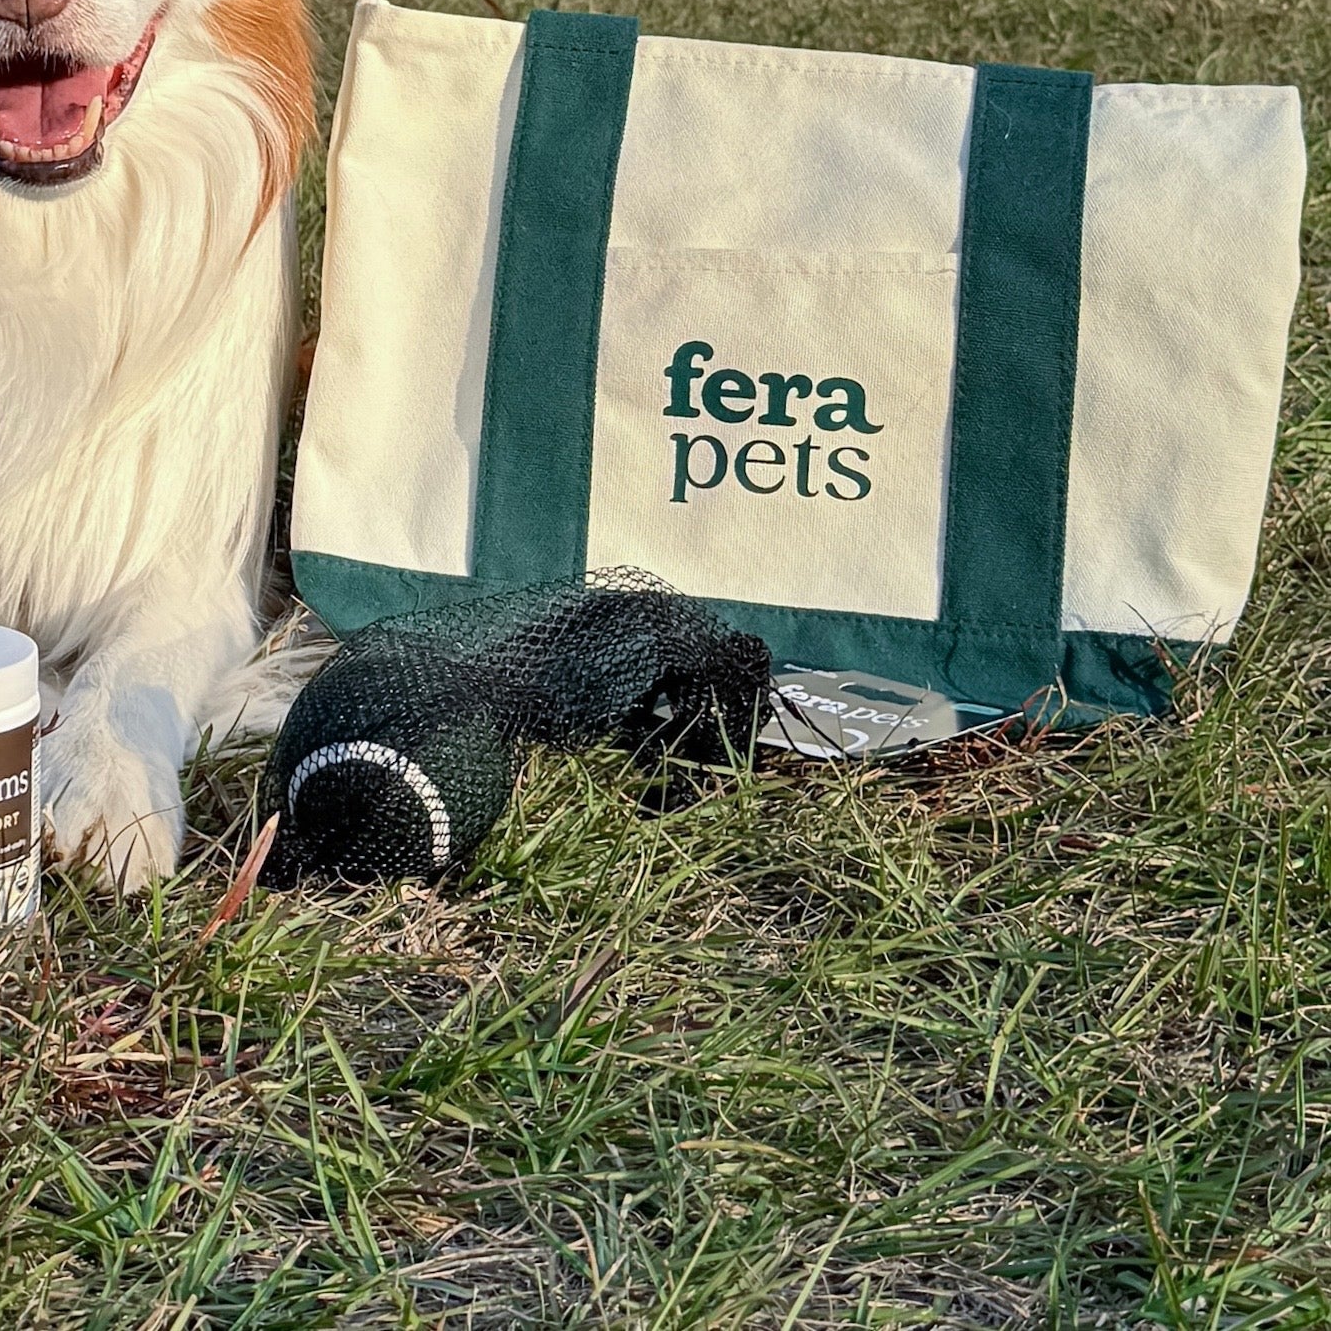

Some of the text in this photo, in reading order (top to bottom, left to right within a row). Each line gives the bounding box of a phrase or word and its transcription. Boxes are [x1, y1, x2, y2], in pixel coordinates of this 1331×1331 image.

[663, 340, 885, 435] fera
[669, 432, 872, 503] pets
[769, 684, 929, 730] fera pets
